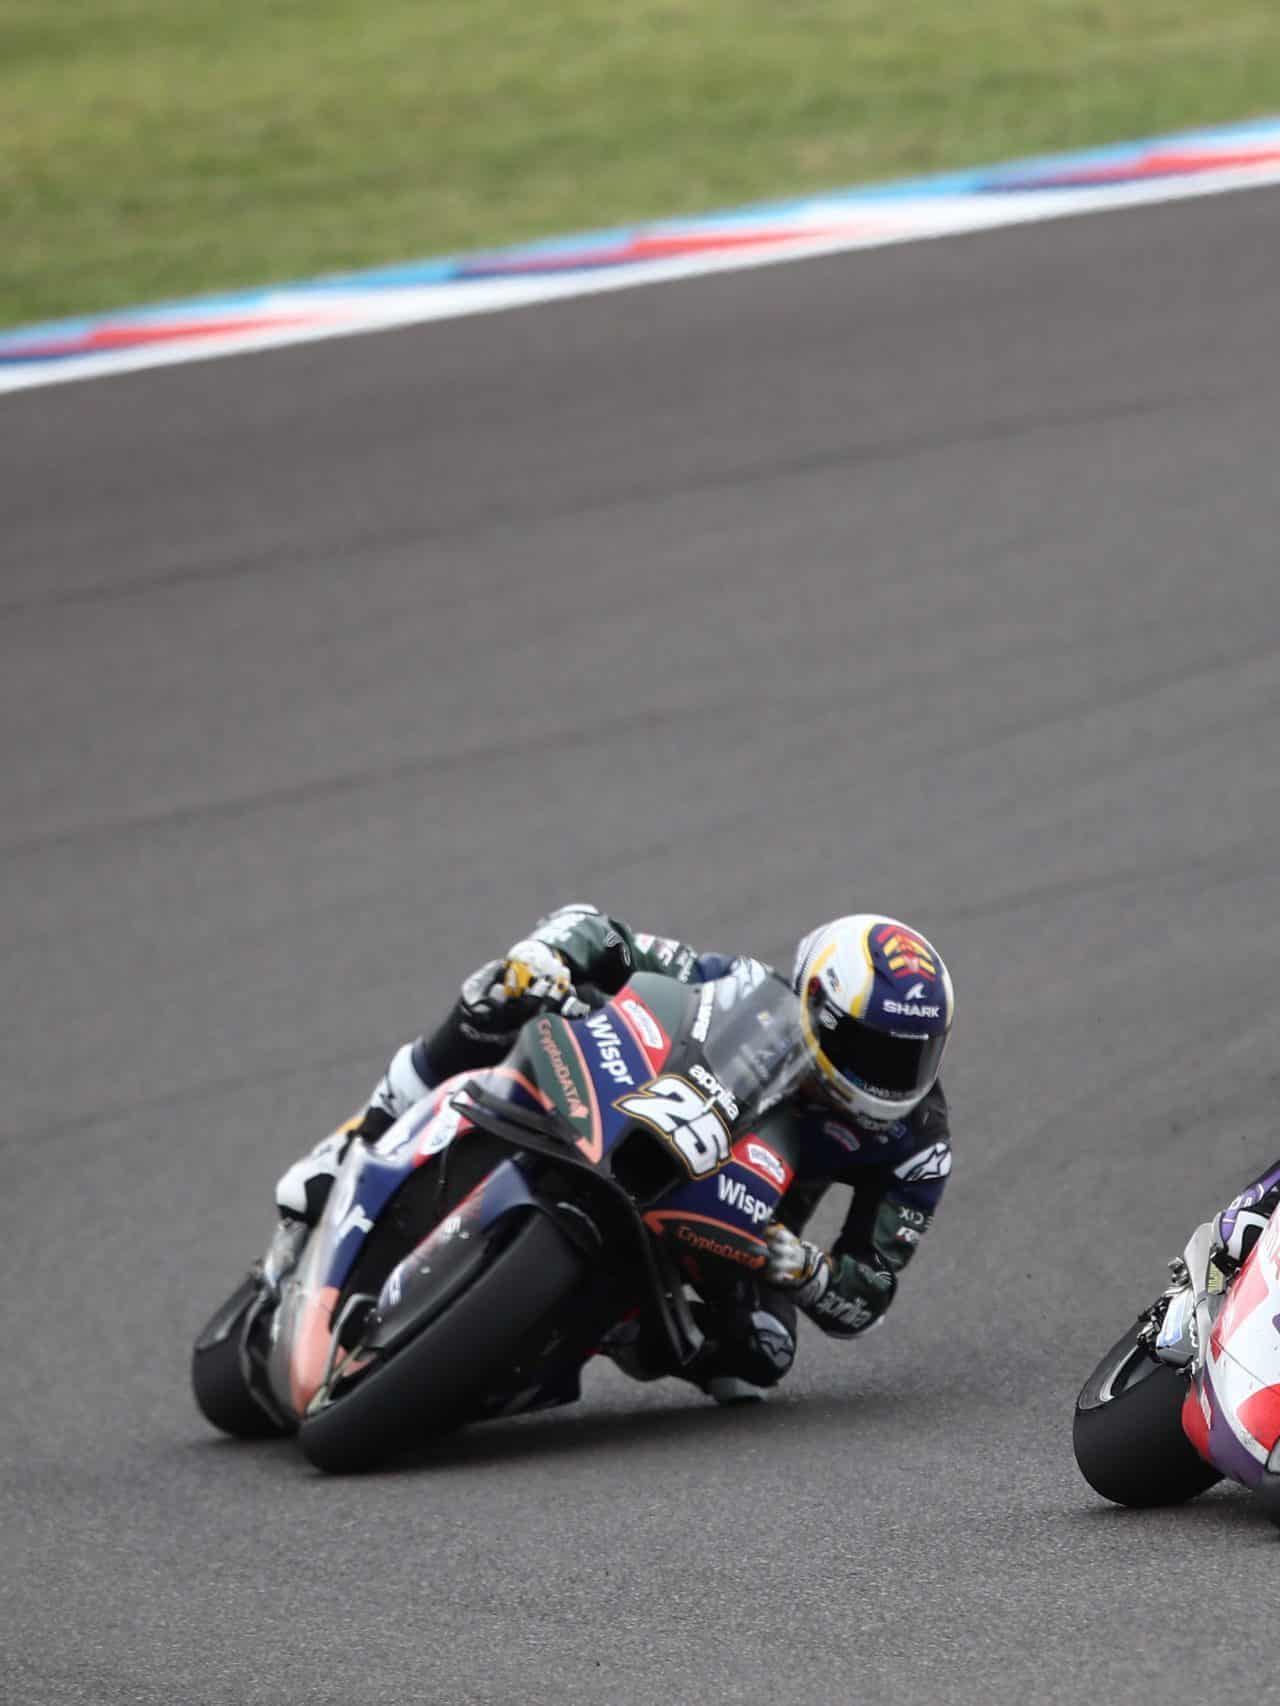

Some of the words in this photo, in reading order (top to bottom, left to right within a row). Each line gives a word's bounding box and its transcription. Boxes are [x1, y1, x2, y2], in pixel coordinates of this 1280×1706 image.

[883, 1000, 940, 1019] SHARK
[585, 1014, 635, 1086] Wispr
[689, 1064, 740, 1121] aprilia
[613, 1073, 734, 1180] 25
